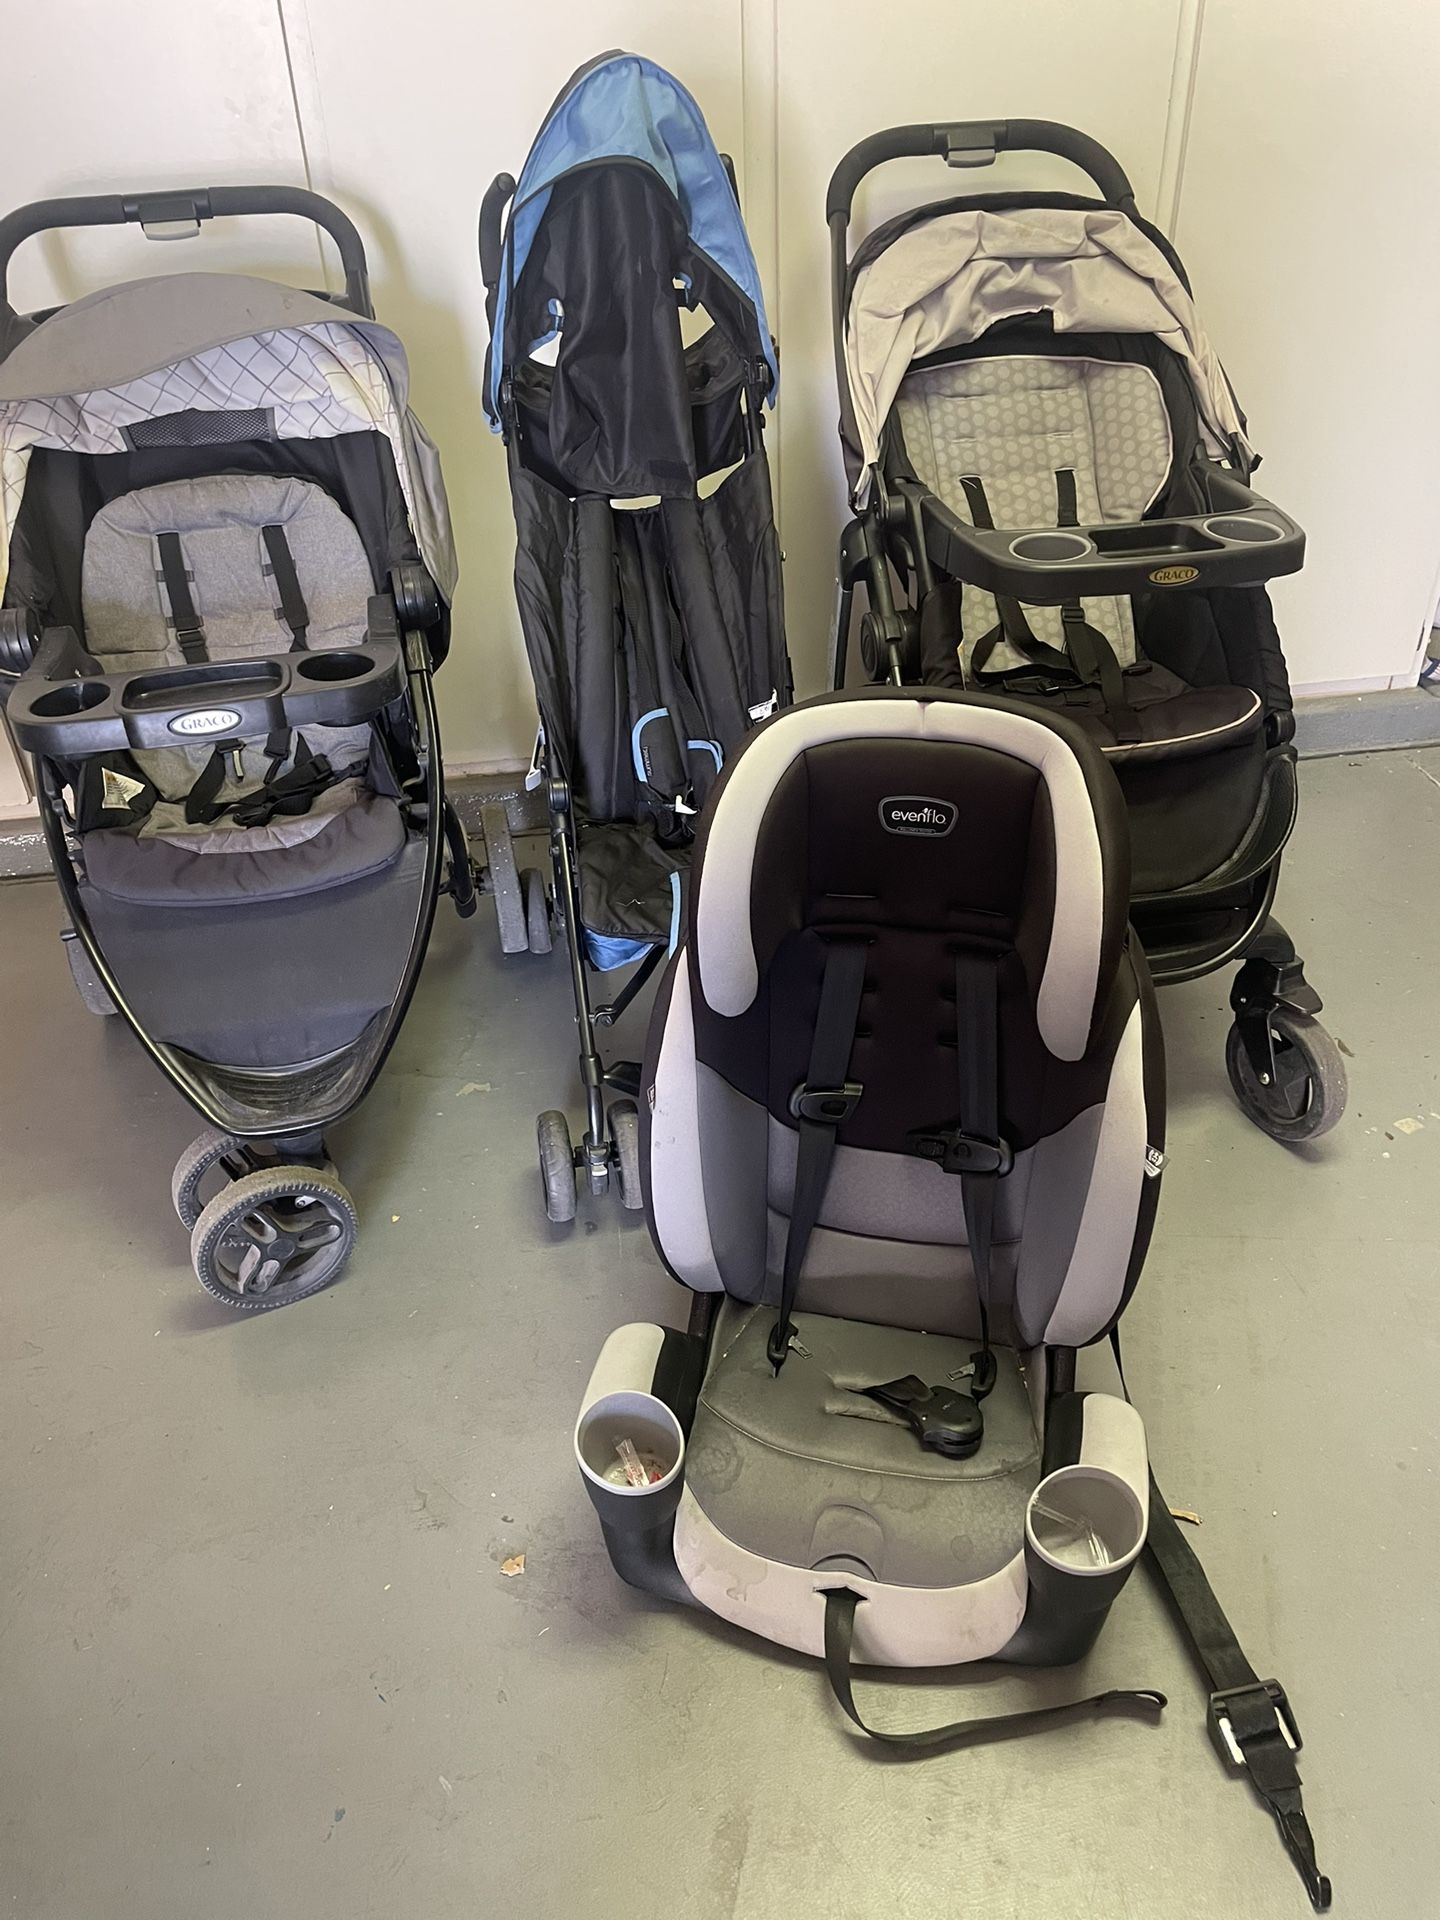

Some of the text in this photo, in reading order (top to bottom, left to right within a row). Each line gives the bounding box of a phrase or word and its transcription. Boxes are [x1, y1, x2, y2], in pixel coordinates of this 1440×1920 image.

[1154, 569, 1194, 581] GRACO
[181, 714, 233, 730] GRACO
[891, 808, 946, 824] evenflo
